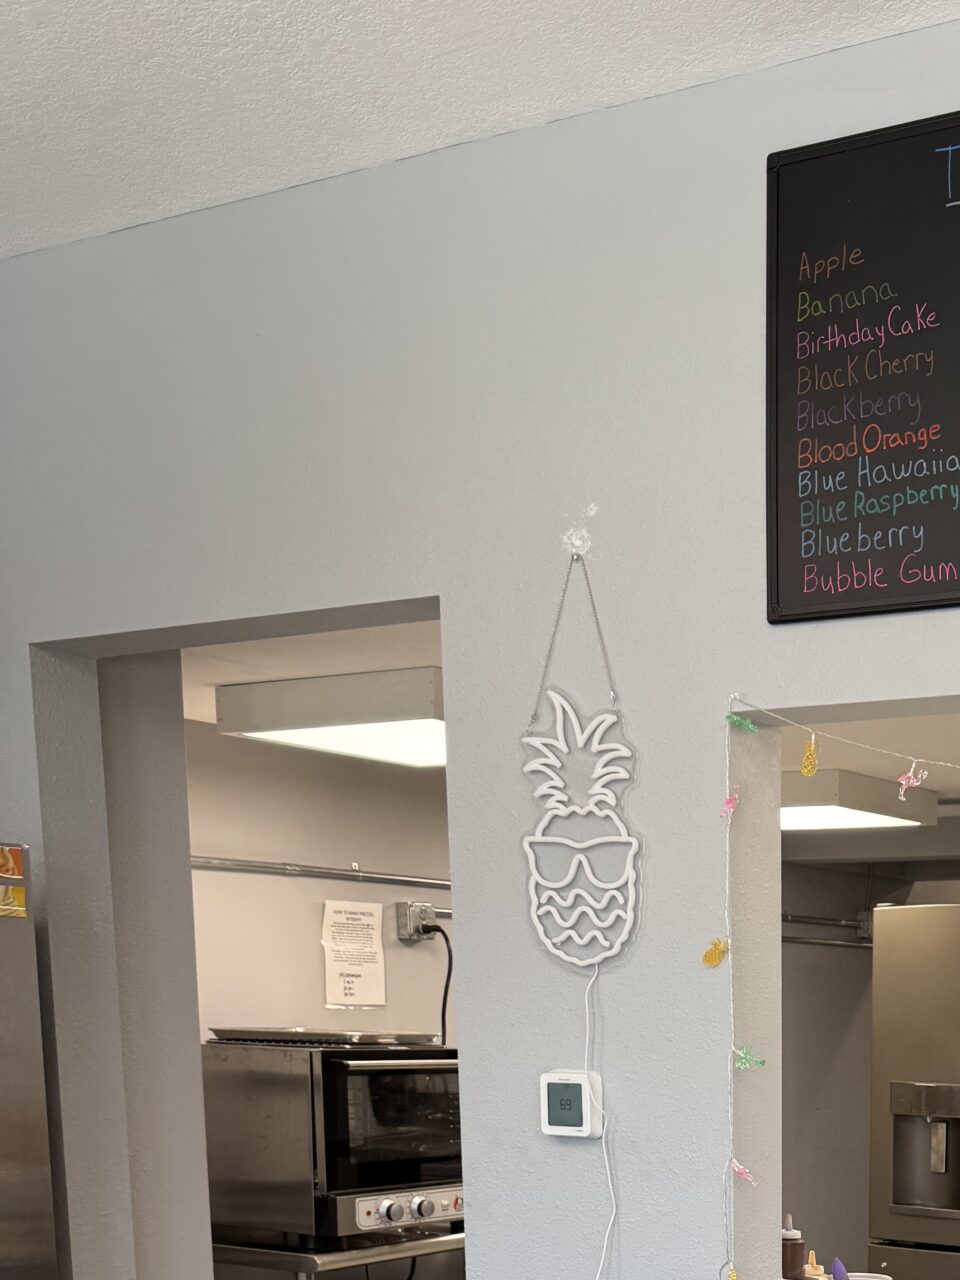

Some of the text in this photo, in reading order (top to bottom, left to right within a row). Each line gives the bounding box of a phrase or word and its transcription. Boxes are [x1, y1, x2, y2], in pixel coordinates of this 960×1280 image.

[799, 244, 865, 284] Apple
[796, 282, 899, 322] Banana
[865, 349, 934, 380] Cherry
[798, 469, 848, 498] Blue
[800, 483, 960, 527] Blue Raspberry
[801, 522, 924, 558] Blueberry
[803, 554, 958, 594] Bubble Gum
